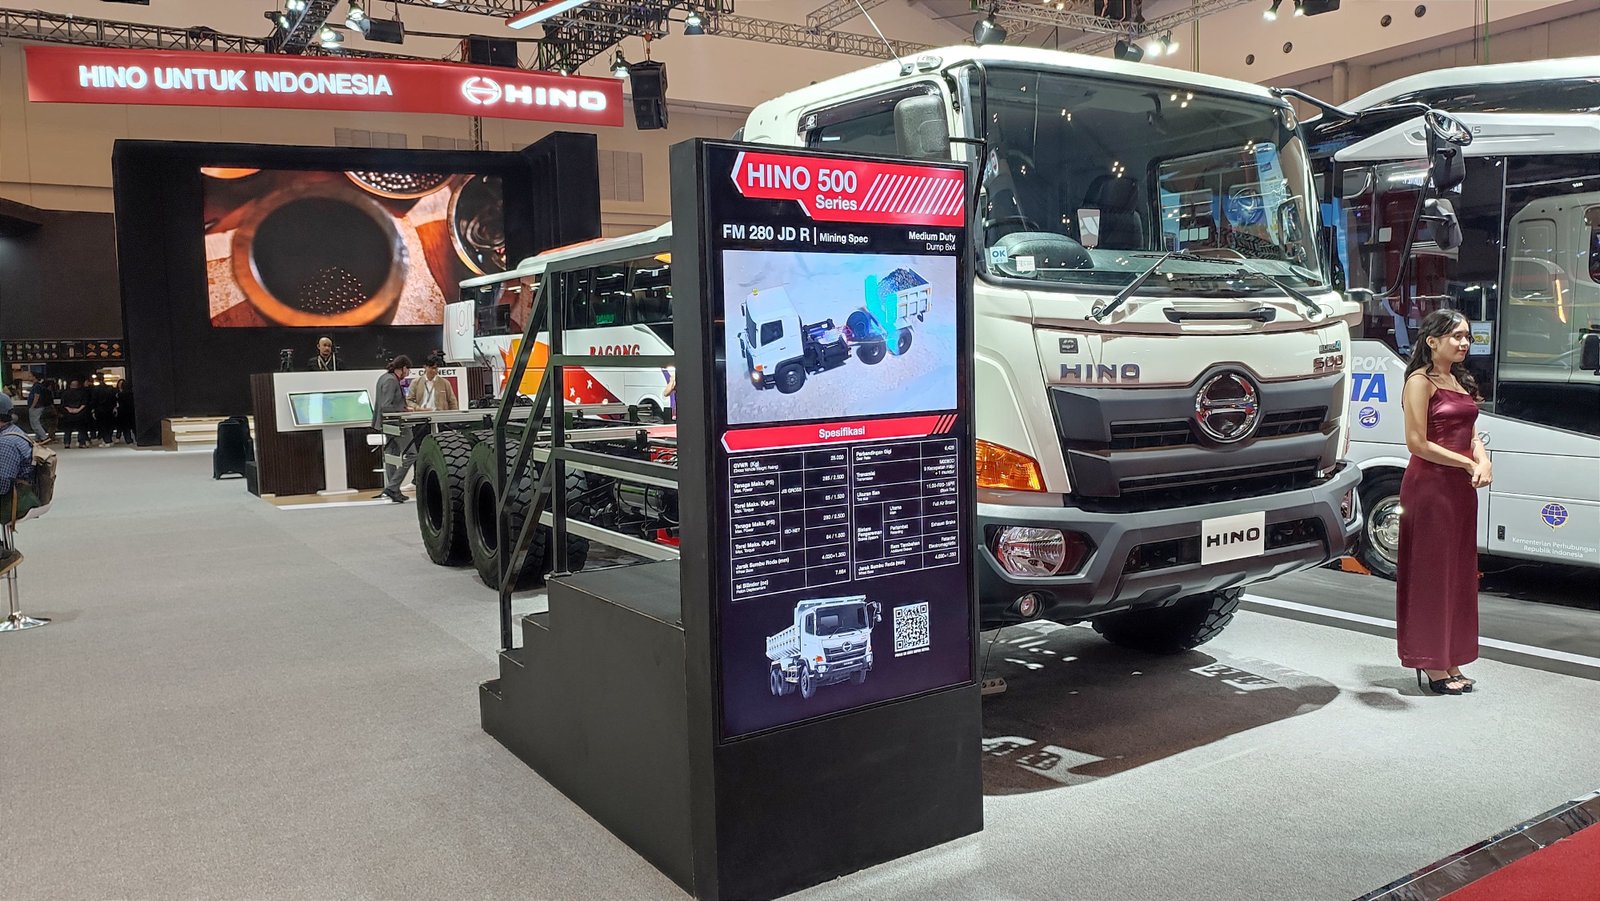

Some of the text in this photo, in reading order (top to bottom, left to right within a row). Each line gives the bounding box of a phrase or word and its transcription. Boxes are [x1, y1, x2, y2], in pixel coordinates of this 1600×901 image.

[79, 65, 393, 96] HINO UNTUK INDONESIA
[505, 84, 607, 111] HINO
[747, 162, 857, 194] HINO 500
[815, 194, 858, 211] Series
[722, 223, 810, 242] FM 280 JD R
[819, 232, 869, 245] Mining Spec
[908, 231, 956, 243] Medium Duty
[926, 242, 956, 252] Dump 6x4
[992, 250, 1006, 258] OK
[1313, 355, 1344, 372] 500
[419, 369, 457, 377] CNECT
[1060, 363, 1141, 383] HINO
[818, 426, 866, 440] Spesifikasi
[1206, 527, 1260, 548] HINO
[1512, 537, 1597, 553] Kementerian Perhubungan
[1523, 545, 1584, 558] Republik Indonesia
